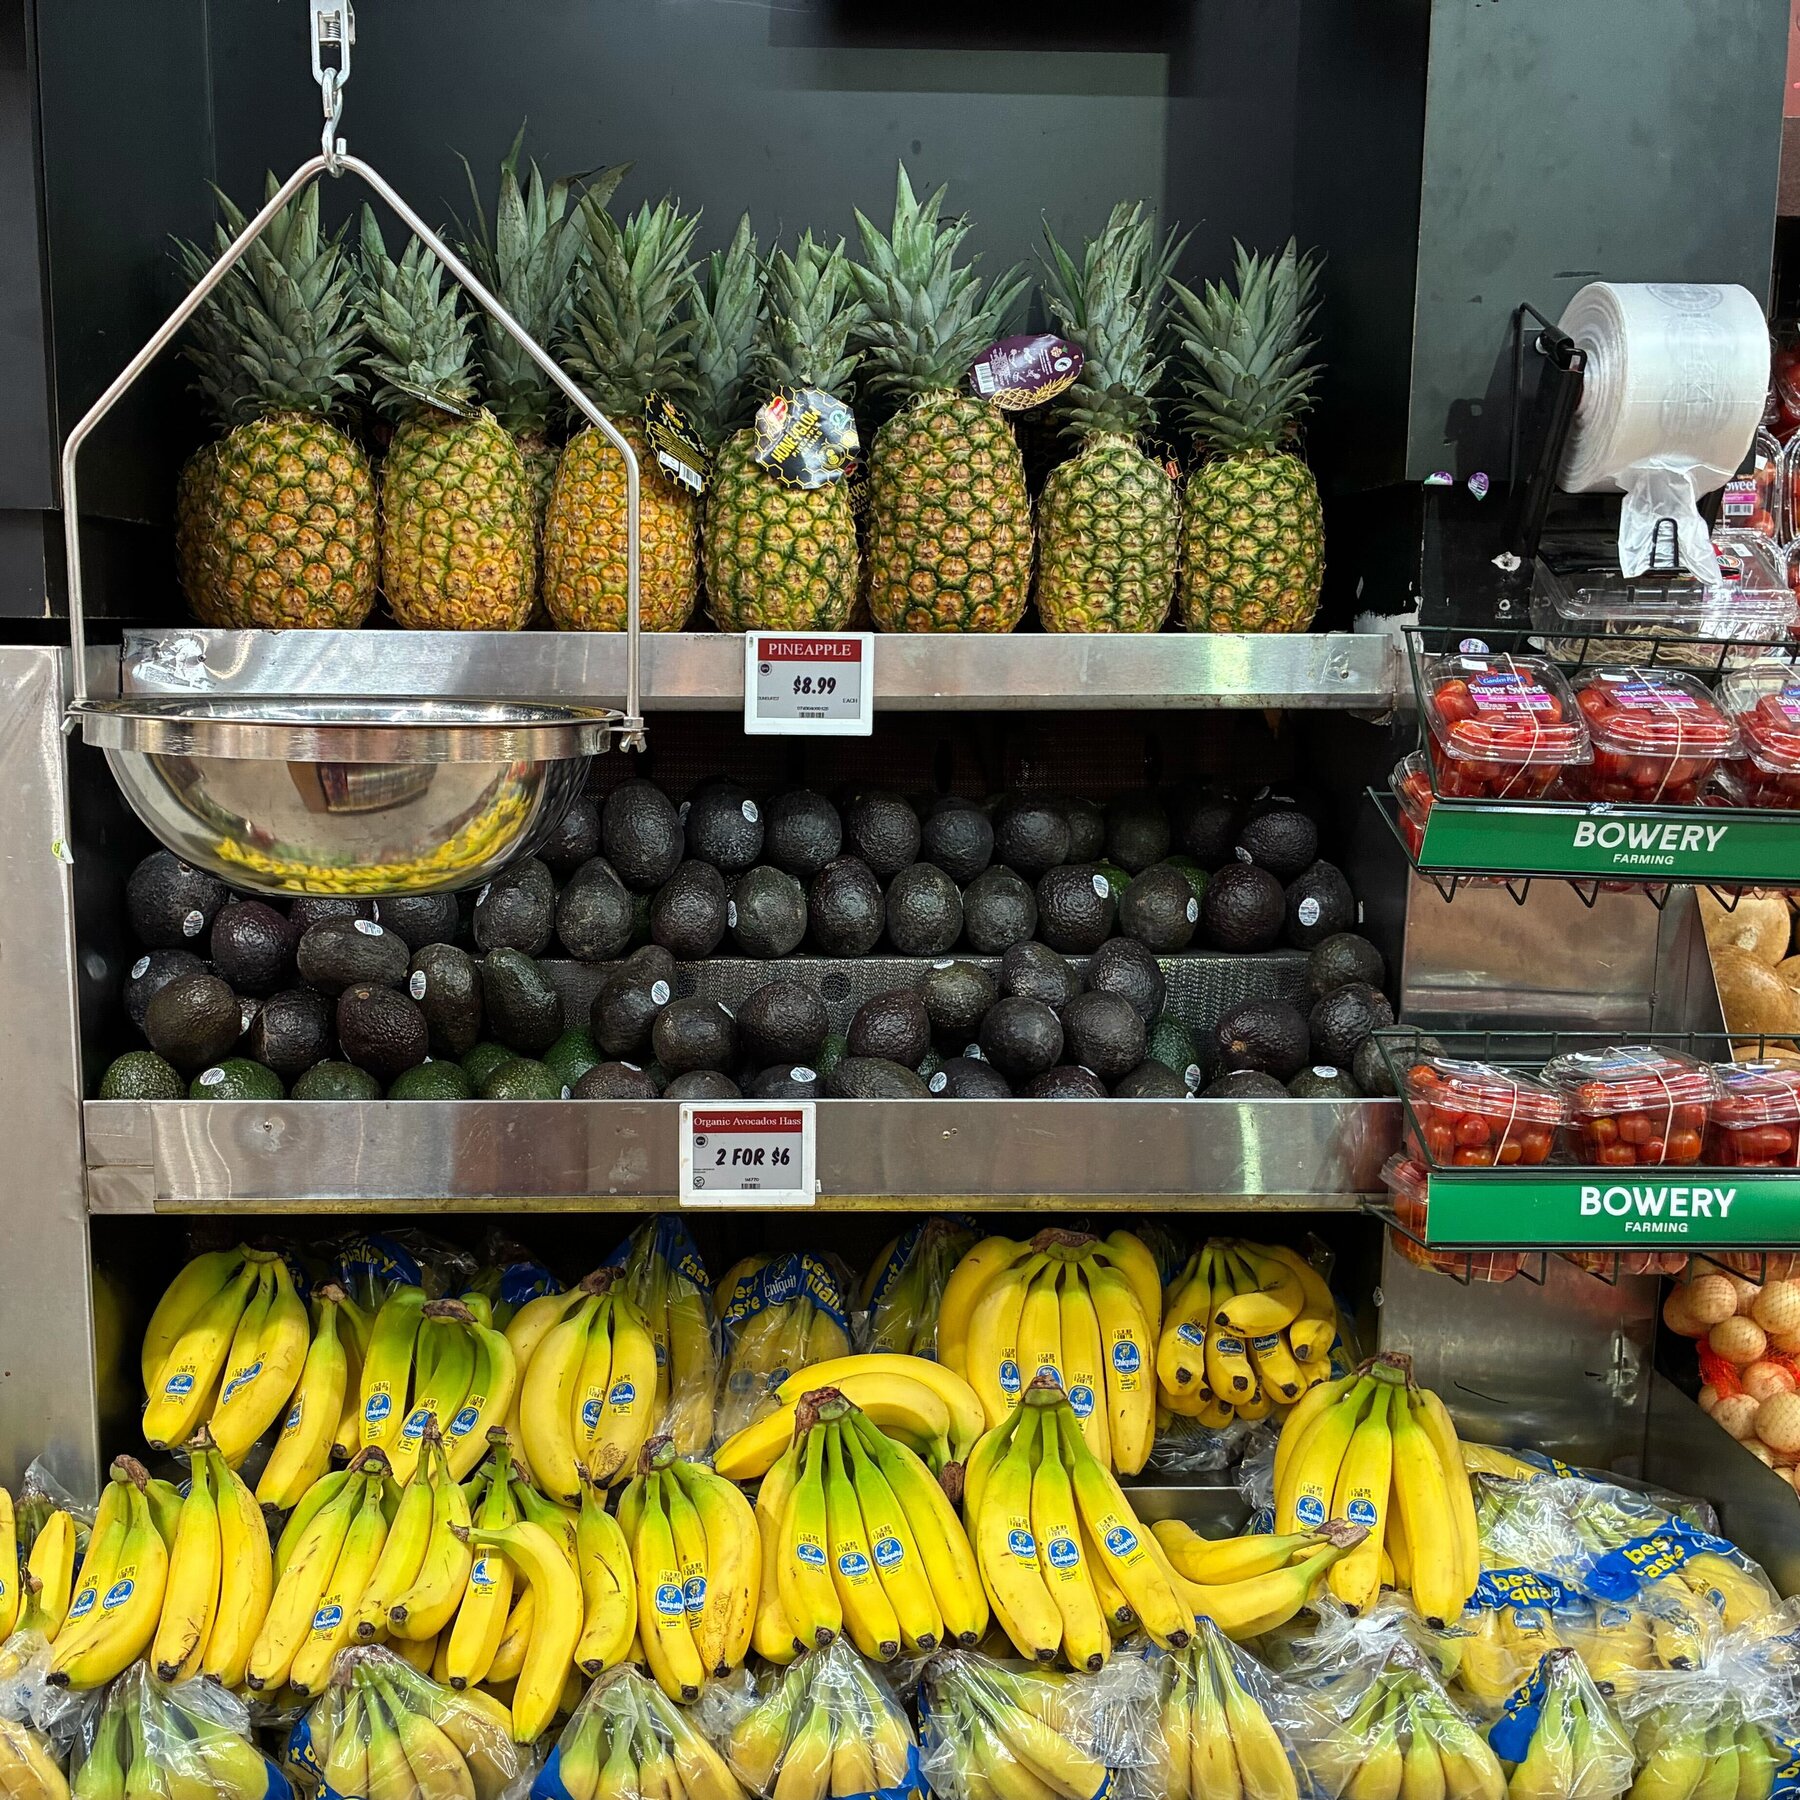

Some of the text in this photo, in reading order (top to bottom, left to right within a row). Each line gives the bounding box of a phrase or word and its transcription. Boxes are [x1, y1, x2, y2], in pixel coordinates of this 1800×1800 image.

[771, 405, 821, 464] HONEYGLOW
[768, 643, 852, 656] PINEAPPLE
[793, 675, 837, 695] $8.99
[1467, 683, 1546, 696] Super Sweet
[1610, 689, 1649, 698] Super
[1573, 821, 1728, 852] BOWERY
[1613, 853, 1675, 865] FARMING
[693, 1116, 802, 1128] Organic Avocados Hass
[715, 1146, 790, 1166] 2 FOR $6
[1580, 1186, 1737, 1218] BOWERY
[1624, 1221, 1689, 1233] FARMING
[679, 1254, 710, 1288] tas
[735, 1277, 760, 1299] est
[764, 1277, 798, 1298] Chiquit
[725, 1296, 761, 1318] aste
[1114, 1357, 1140, 1367] Chiquita
[1000, 1377, 1020, 1387] Chiquita
[610, 1393, 634, 1403] Chiquita
[1070, 1400, 1093, 1413] hiquita
[584, 1412, 599, 1423] Chiq
[405, 1423, 424, 1433] Chiquit
[1298, 1508, 1323, 1521] Chiquita
[1350, 1512, 1376, 1524] Chiquita
[1010, 1543, 1037, 1554] Chiquita
[1112, 1537, 1138, 1555] Chiquita
[1622, 1536, 1674, 1565] bes
[799, 1553, 825, 1563] Chiquita
[879, 1550, 903, 1564] Chiquita
[1050, 1554, 1079, 1564] Chiquita
[843, 1564, 869, 1574] Chiquita
[1490, 1574, 1536, 1592] bes
[106, 1593, 130, 1605] Chiquita
[658, 1600, 684, 1610] Chiquita
[316, 1617, 340, 1626] Chiquita
